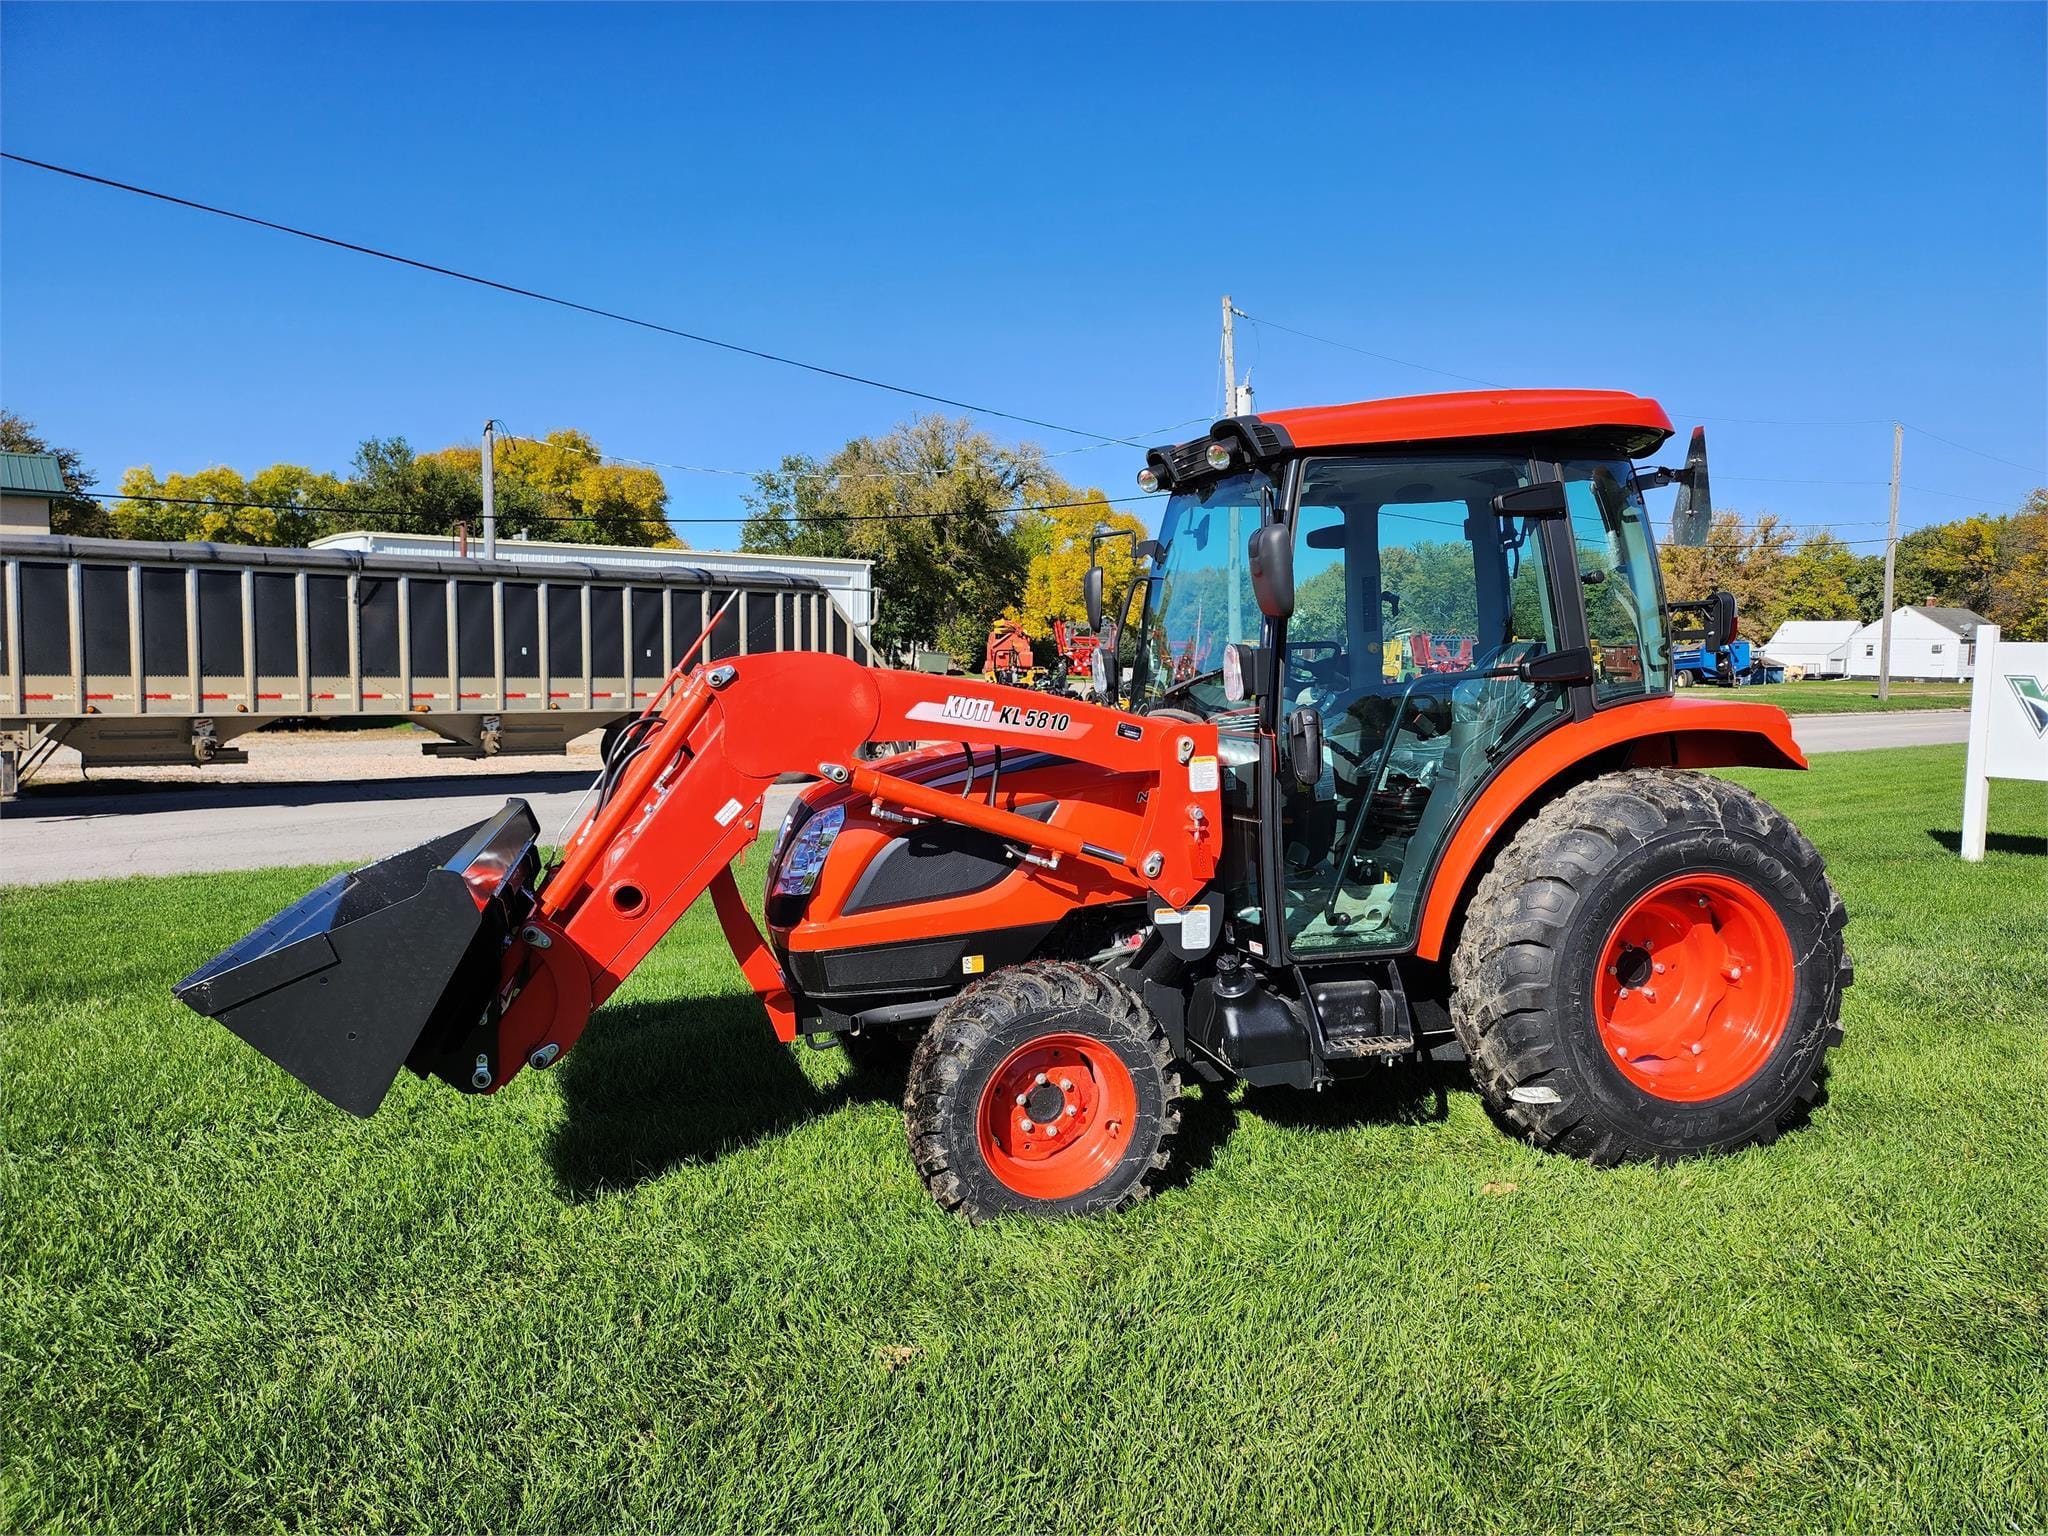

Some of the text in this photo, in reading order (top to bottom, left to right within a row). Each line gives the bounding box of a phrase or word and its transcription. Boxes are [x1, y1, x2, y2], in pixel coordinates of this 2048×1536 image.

[942, 695, 1070, 732] KIOTI KL 5810
